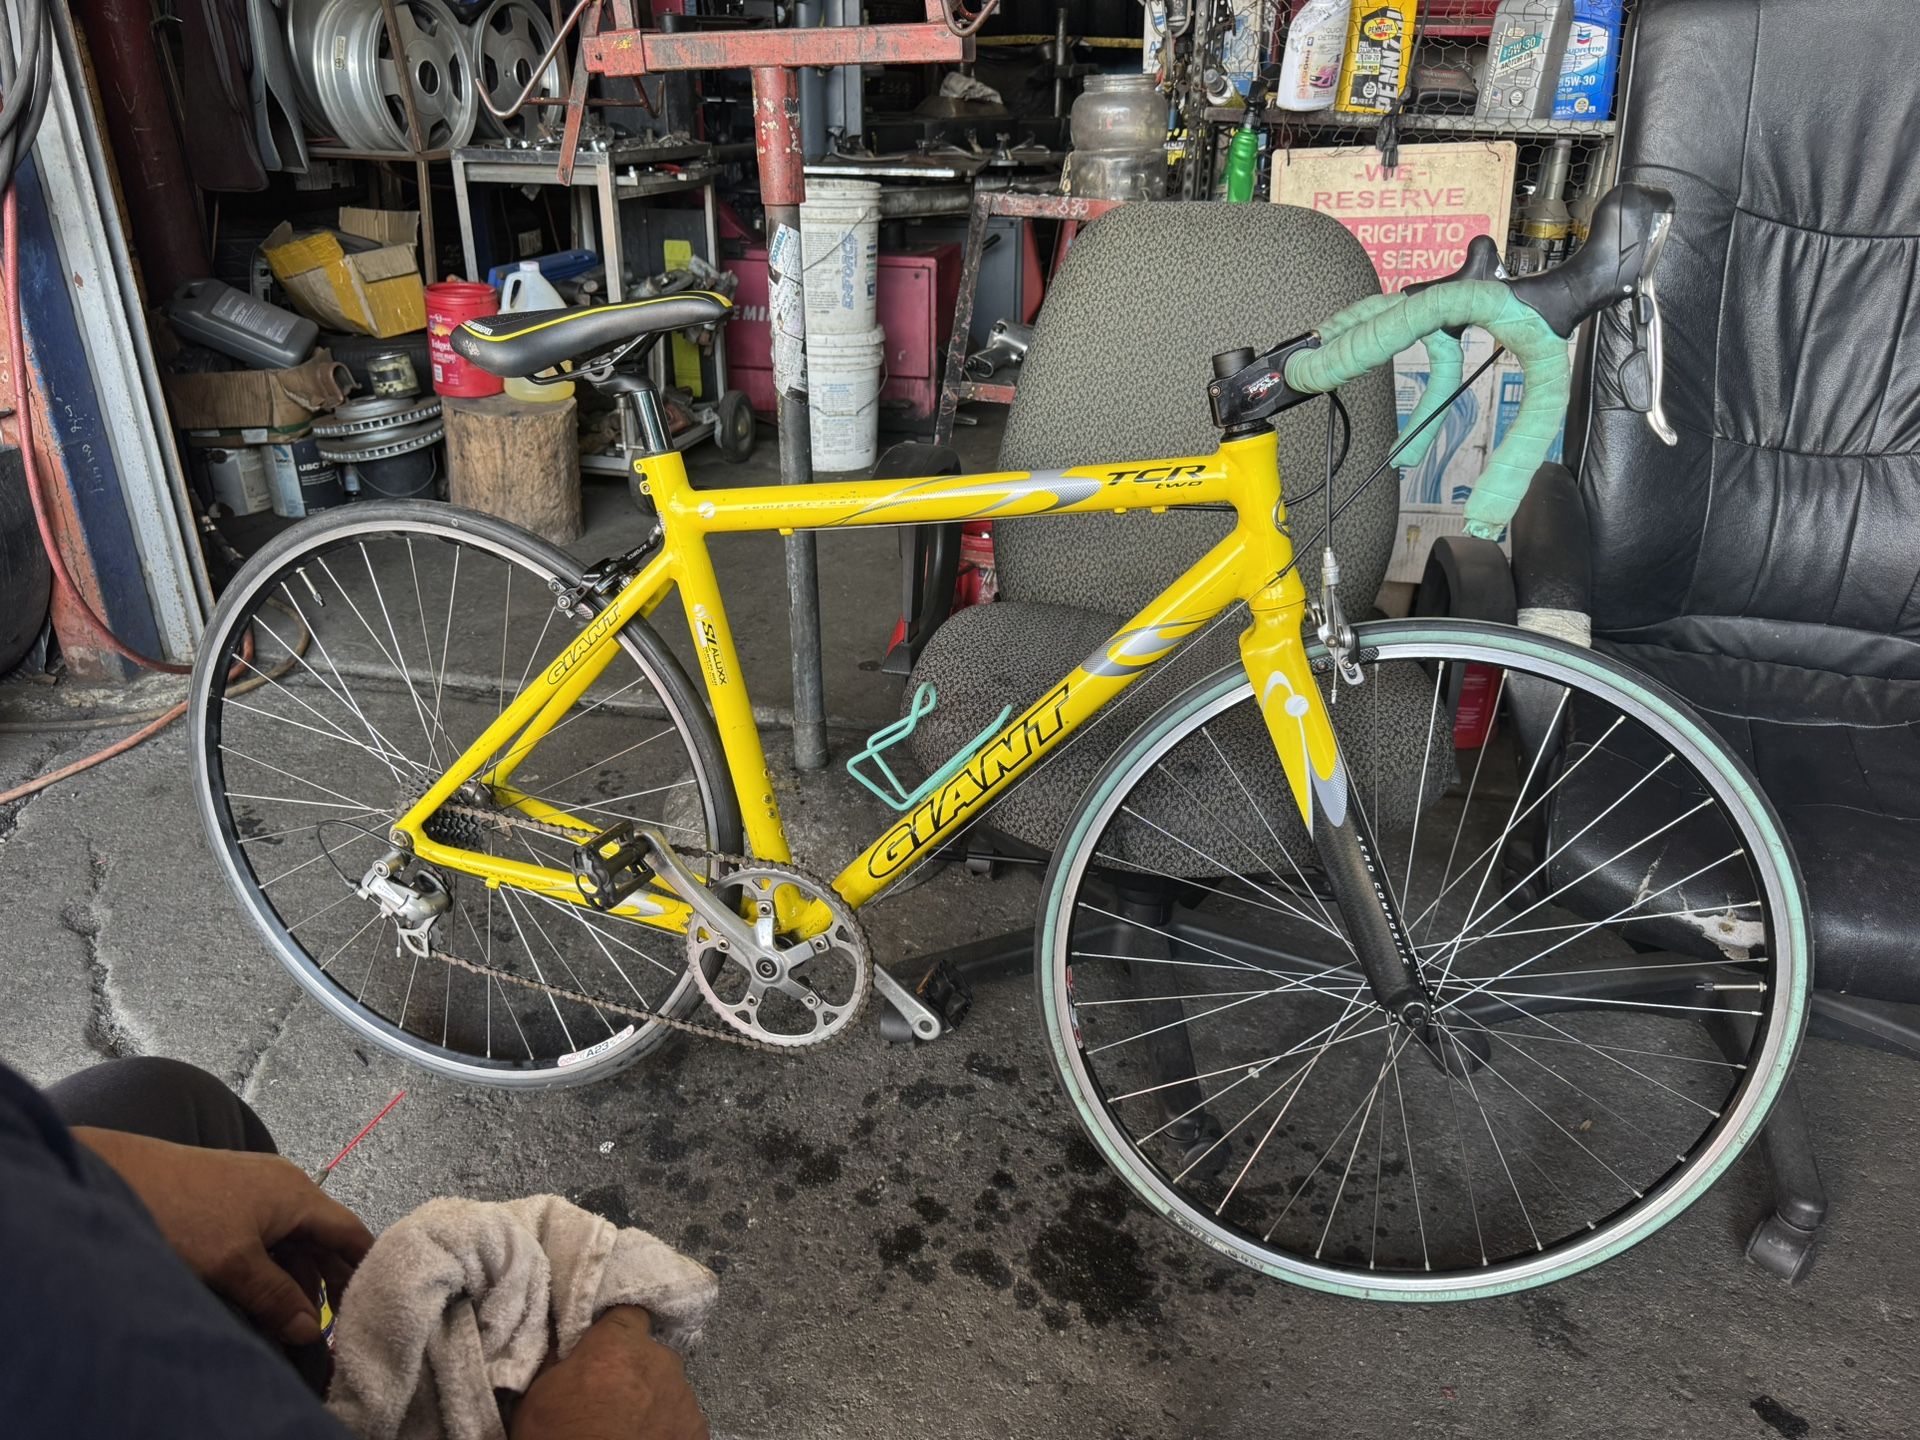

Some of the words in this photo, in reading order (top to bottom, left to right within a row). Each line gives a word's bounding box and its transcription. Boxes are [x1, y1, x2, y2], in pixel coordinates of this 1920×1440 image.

[1368, 24, 1394, 34] PENNZOIL
[1564, 75, 1596, 87] 5W-30
[1312, 188, 1465, 210] RESERVE
[1357, 224, 1428, 244] RIGHT
[1429, 222, 1465, 243] TO
[1382, 249, 1466, 270] SERVIC
[1107, 465, 1206, 486] TCR
[1155, 481, 1203, 489] two
[547, 603, 620, 685] GIANT
[702, 621, 717, 650] SL
[711, 647, 727, 685] ALUXX
[868, 682, 1069, 878] GIANT
[1356, 834, 1375, 873] AERO
[1373, 881, 1410, 965] COMPOSITE
[586, 1041, 609, 1058] A23
